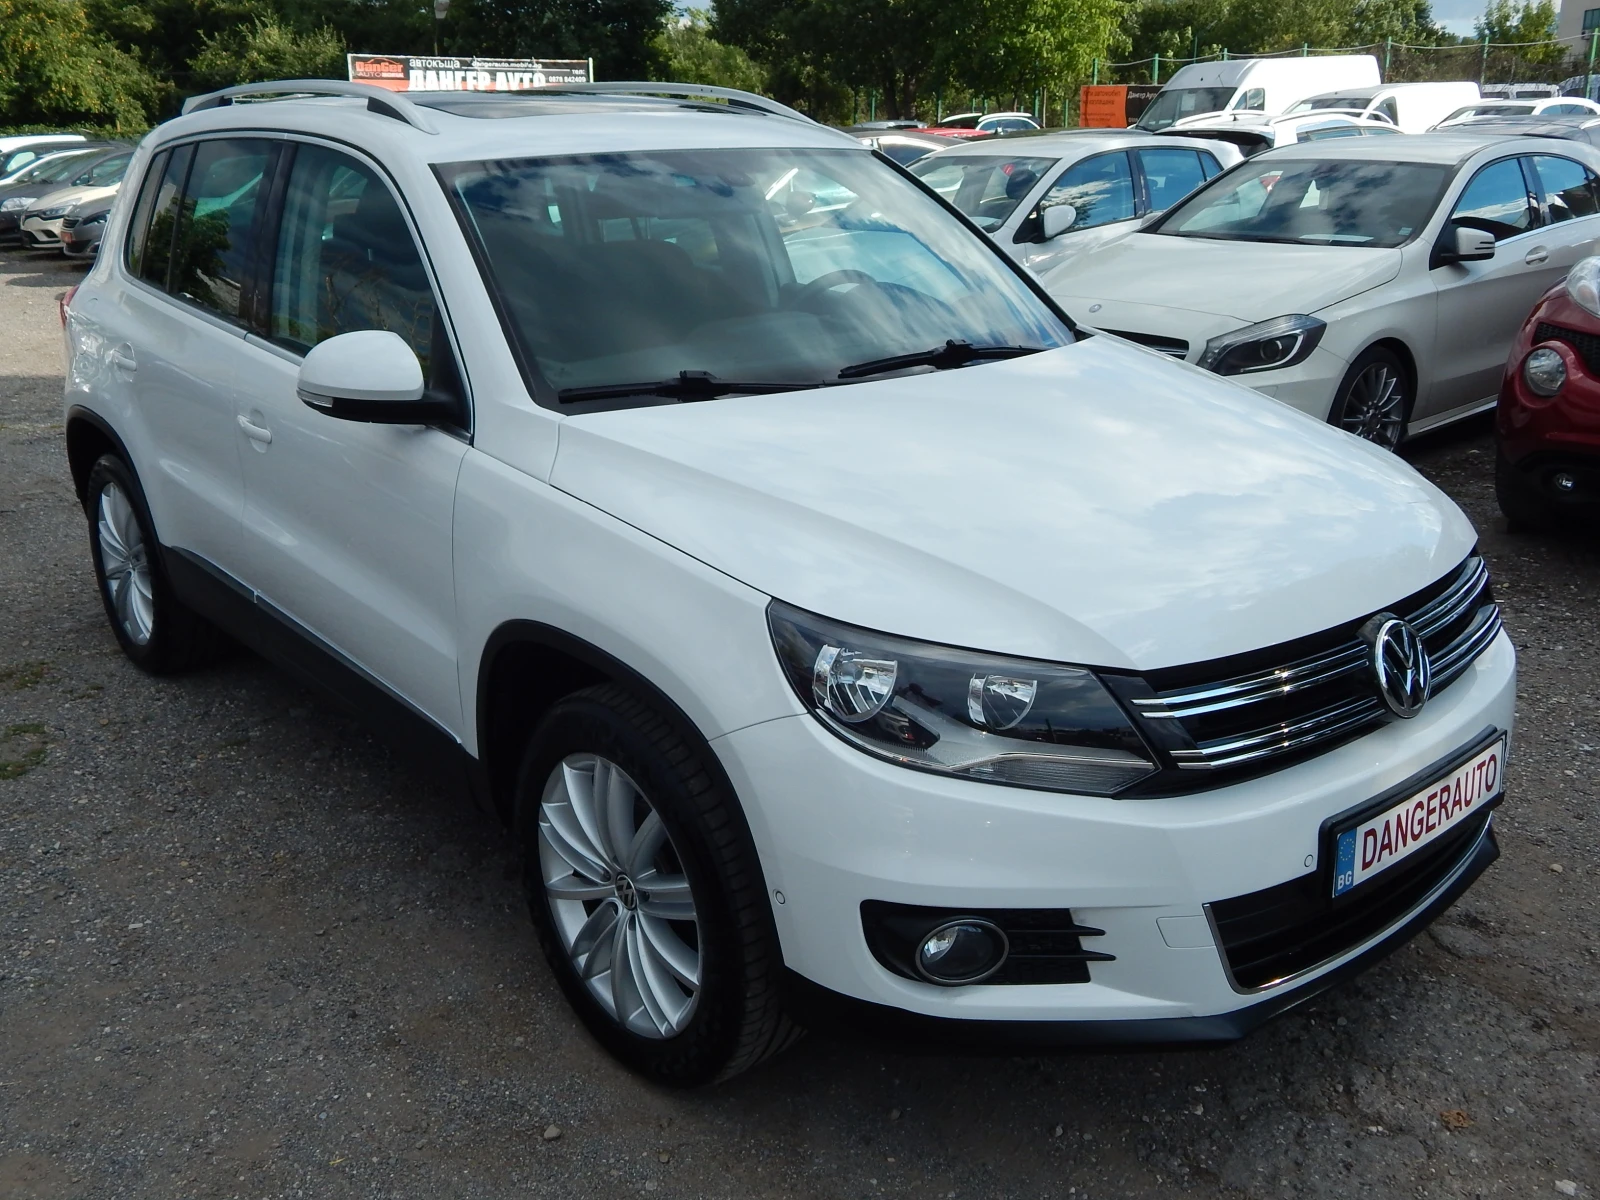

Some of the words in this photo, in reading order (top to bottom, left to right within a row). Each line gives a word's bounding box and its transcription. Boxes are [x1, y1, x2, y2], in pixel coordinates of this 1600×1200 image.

[409, 58, 460, 69] автокъща
[408, 70, 491, 91] ДАНГЕР
[1361, 753, 1497, 871] DANGERAUTO
[1337, 870, 1352, 891] BG
